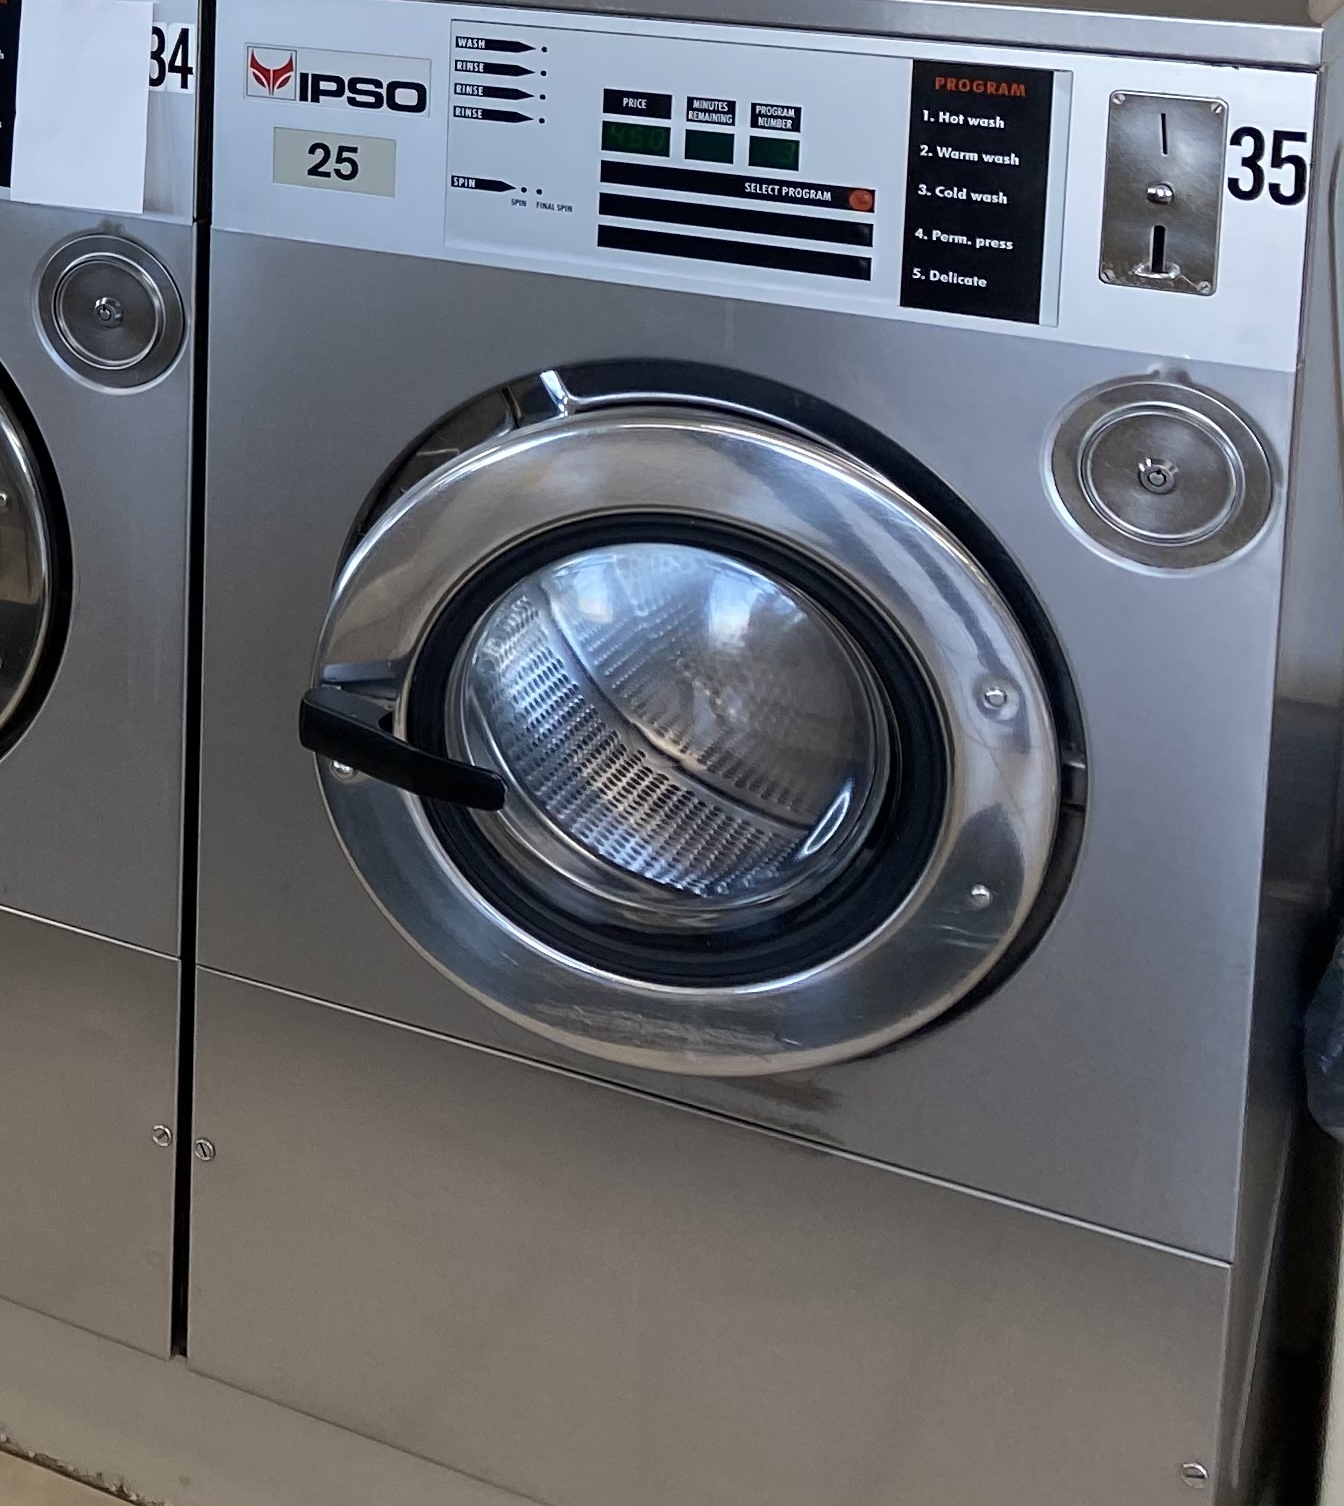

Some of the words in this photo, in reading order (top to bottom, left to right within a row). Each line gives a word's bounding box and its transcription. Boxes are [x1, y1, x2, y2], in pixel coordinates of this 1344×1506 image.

[458, 37, 485, 49] WASH
[456, 61, 484, 72] RINSE
[299, 72, 428, 114] IPSO
[456, 84, 484, 96] RINSE
[935, 76, 1026, 97] PROGRAM
[623, 97, 647, 110] PRICE
[693, 99, 728, 112] MINUTES
[756, 105, 795, 118] PROGRAM
[455, 107, 483, 119] RINSE
[688, 110, 733, 124] REMAINING
[922, 110, 935, 122] 1.
[939, 112, 965, 126] Hot
[968, 114, 1005, 130] wash
[758, 116, 792, 130] NUMBER
[307, 142, 359, 181] 25
[919, 145, 933, 157] 2.
[936, 147, 979, 162] Warm
[982, 152, 1020, 167] wash
[1227, 126, 1309, 206] 35
[453, 176, 475, 188] SPIN
[744, 182, 780, 196] SELECT
[782, 186, 832, 202] PROGRAM
[917, 184, 931, 196] 3.
[935, 185, 966, 201] Cold
[969, 189, 1008, 205] wash
[915, 228, 928, 240] 4.
[932, 230, 972, 246] Perm.
[976, 235, 1014, 252] press
[912, 269, 926, 281] 5.
[929, 270, 987, 289] Delicate
